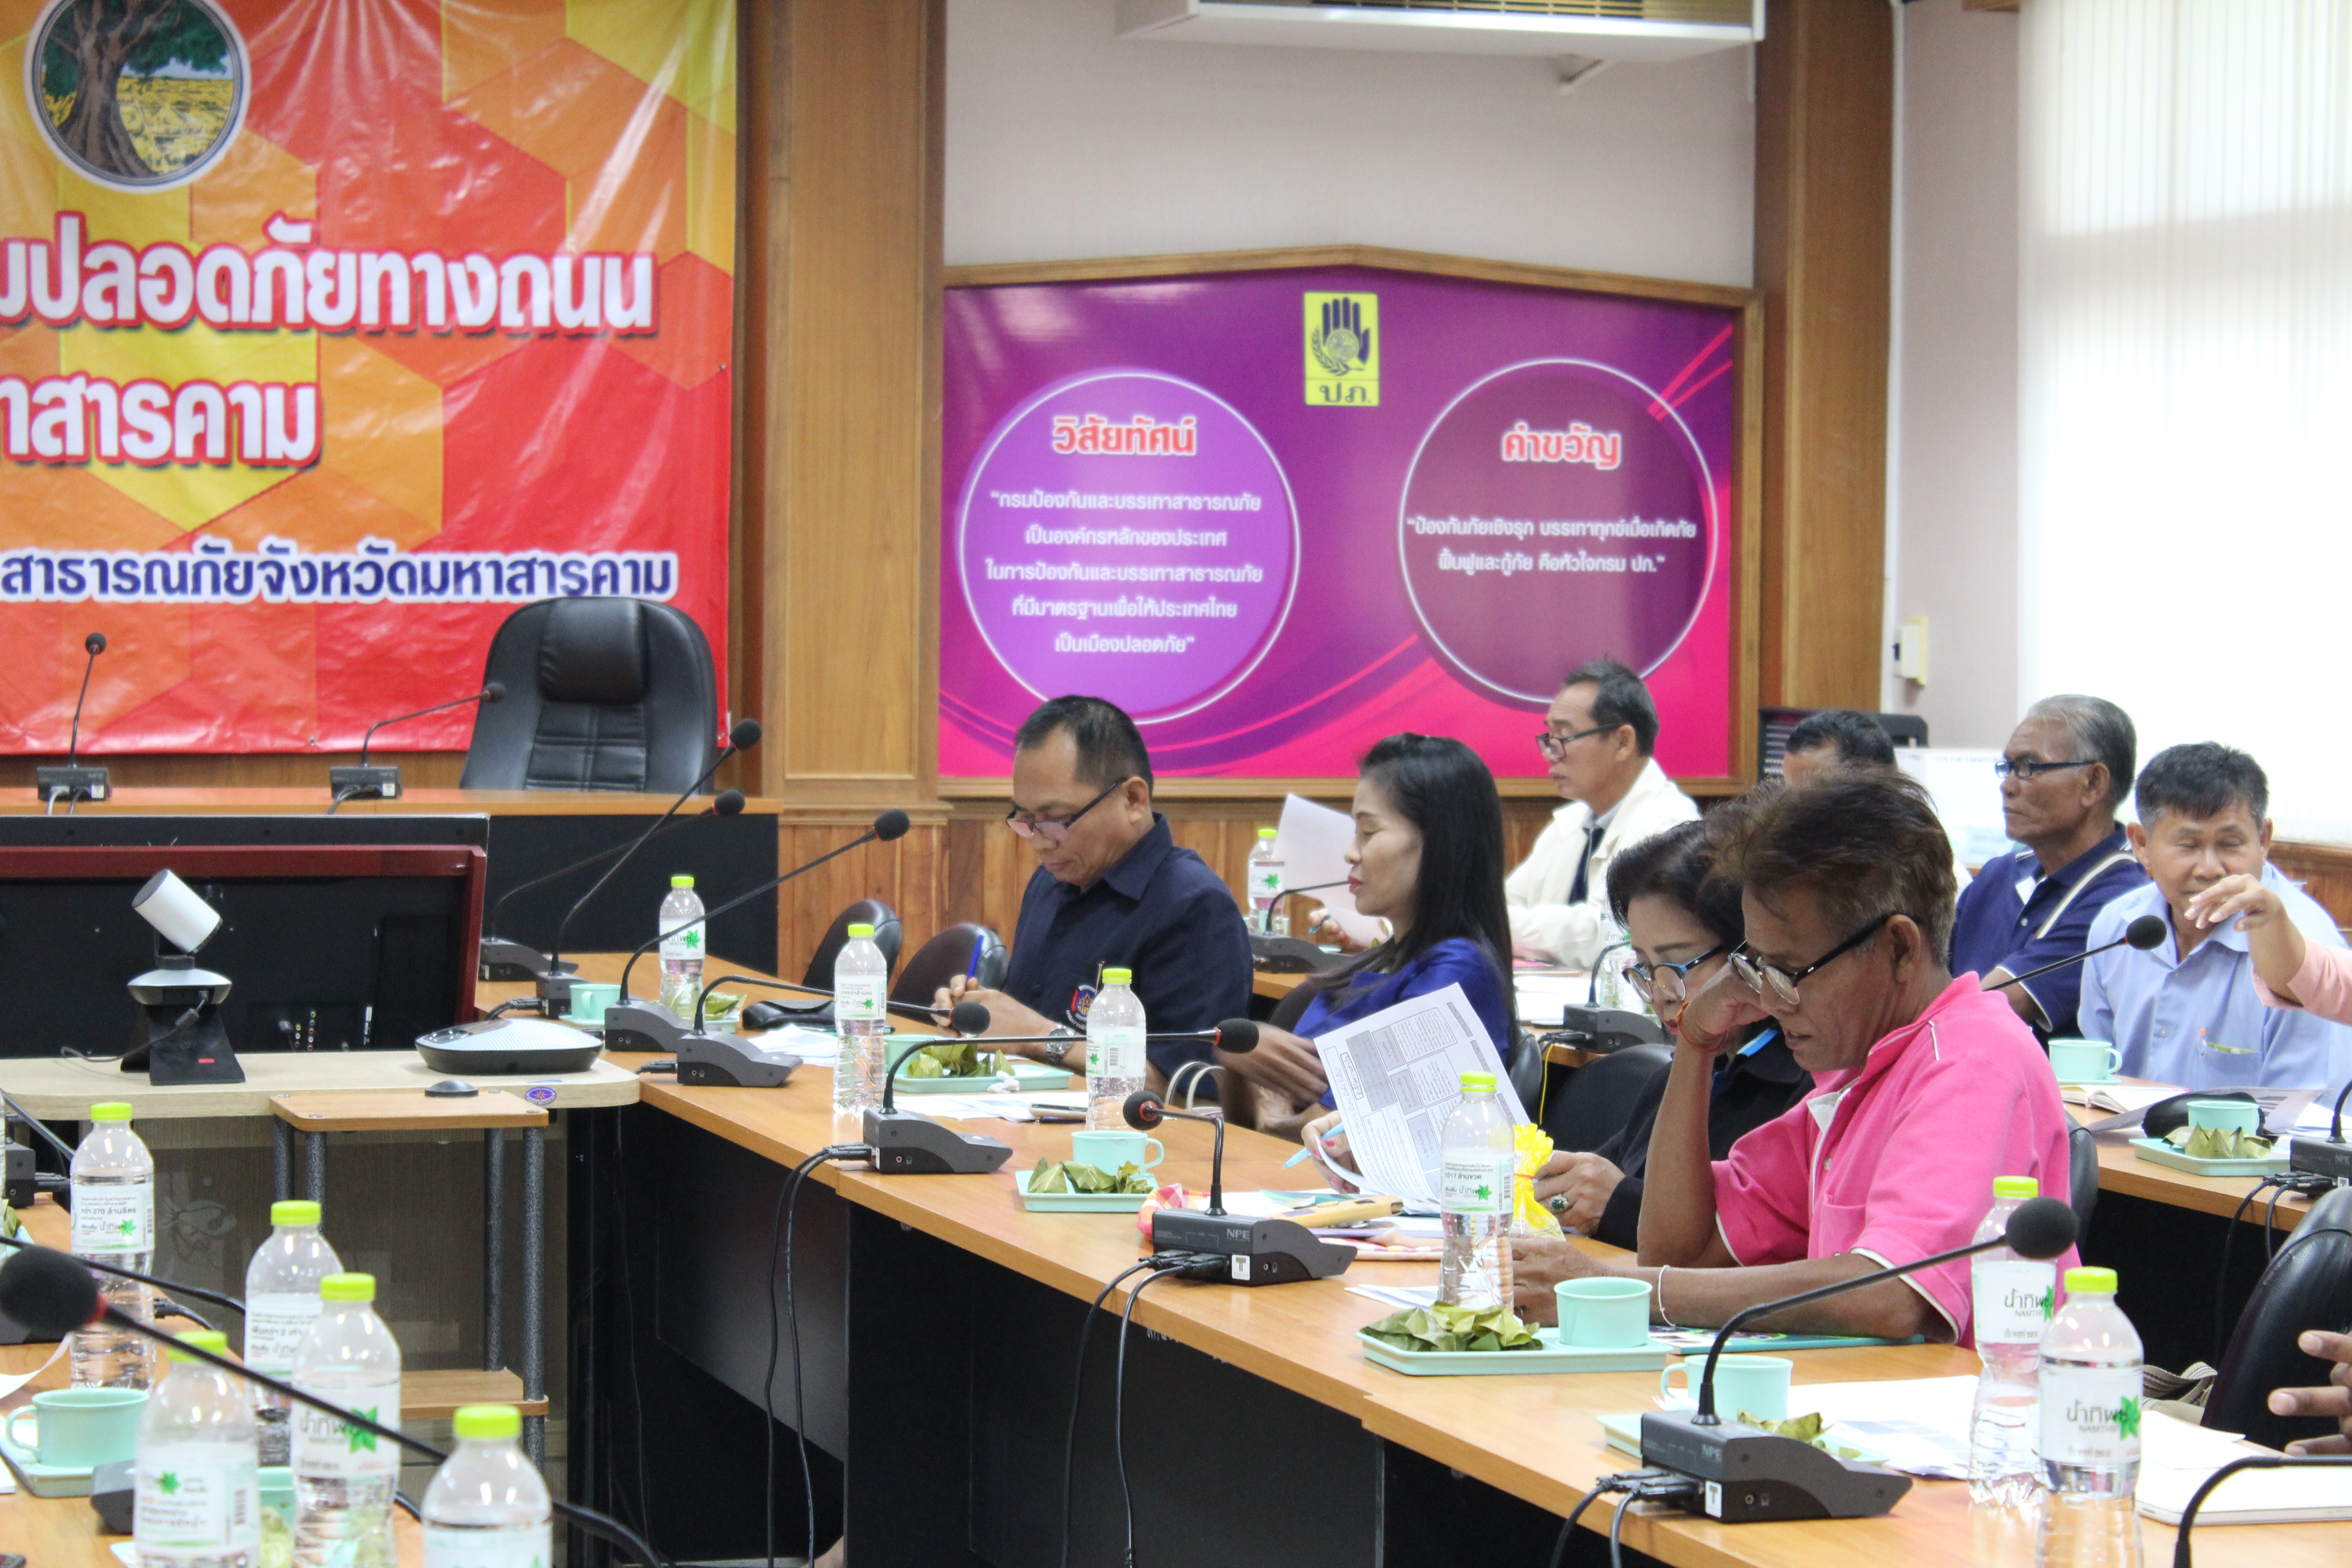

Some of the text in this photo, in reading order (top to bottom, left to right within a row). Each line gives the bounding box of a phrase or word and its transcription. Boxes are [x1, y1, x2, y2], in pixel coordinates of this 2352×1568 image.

[1319, 381, 1372, 404] ปภ.
[1053, 415, 1196, 456] วิสัยทัศน์
[1502, 421, 1621, 469] คำขวัญ
[1025, 525, 1227, 547] เป็นองค์กรหลักของประเทศ
[985, 558, 1263, 583] ในการป้องกันและบรรเทาสาธารณภัย
[1539, 549, 1626, 572] คือหัวใจกรม
[1011, 595, 1238, 621] ที่มีมาตรฐานเพื่อให้ประเทศไทย
[1226, 1228, 1250, 1240] NPE
